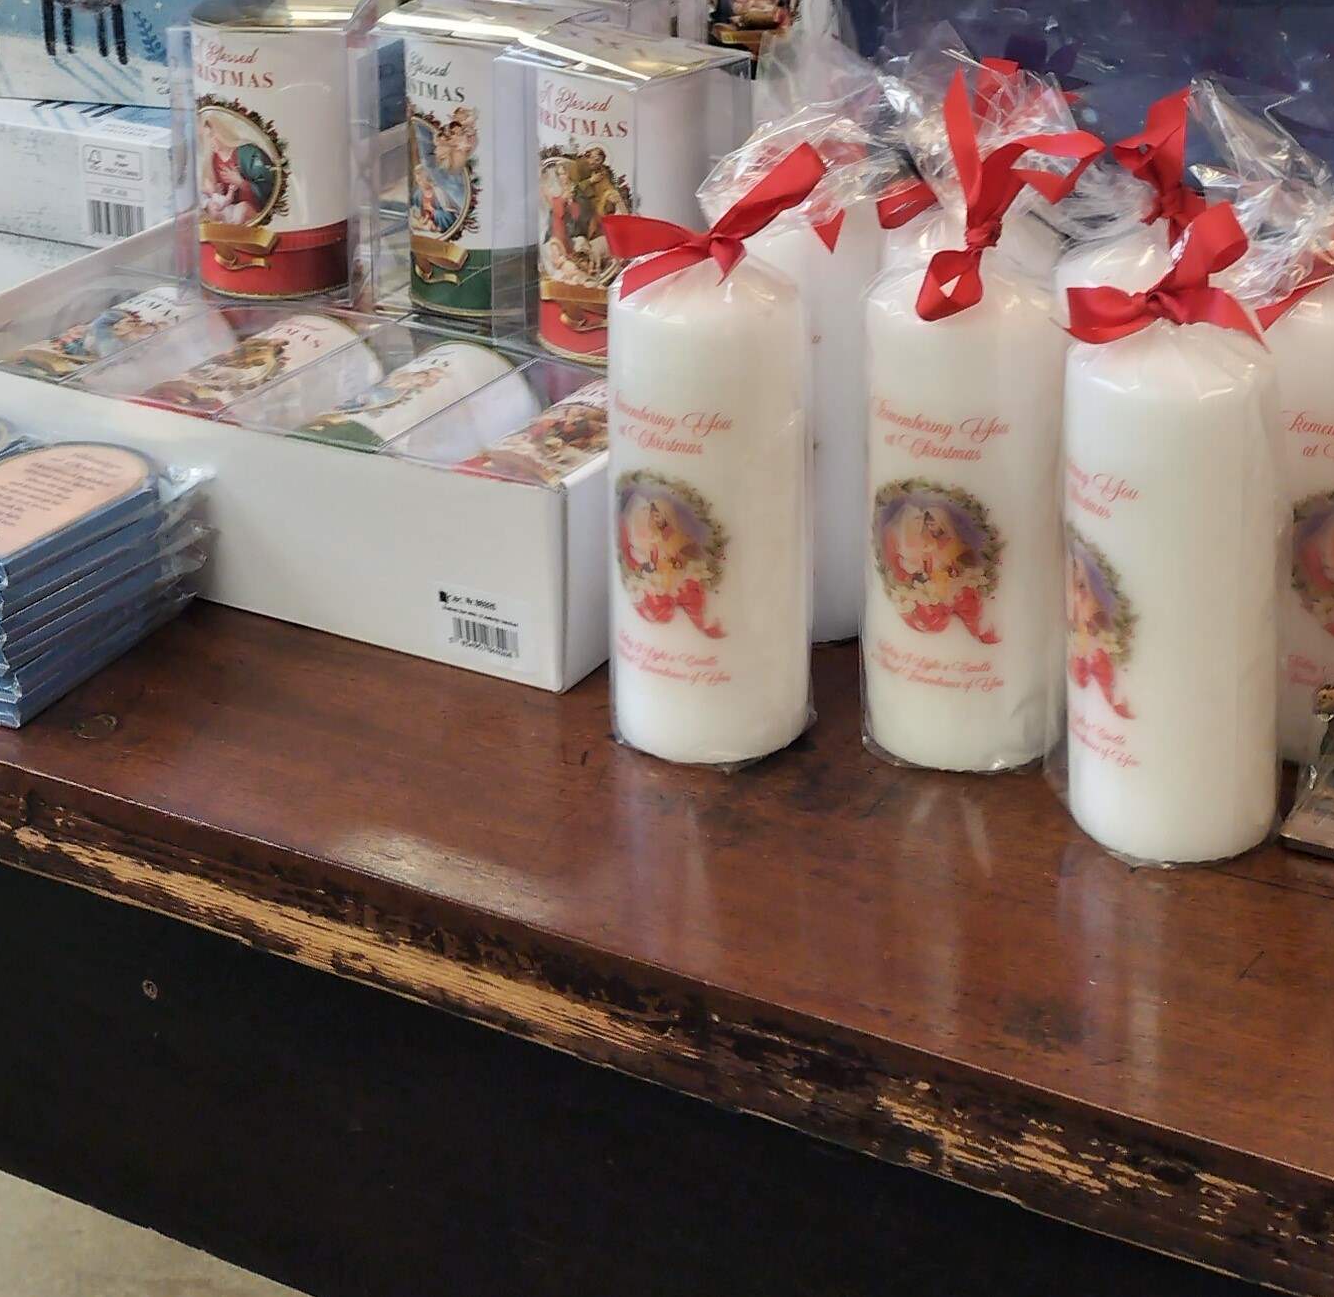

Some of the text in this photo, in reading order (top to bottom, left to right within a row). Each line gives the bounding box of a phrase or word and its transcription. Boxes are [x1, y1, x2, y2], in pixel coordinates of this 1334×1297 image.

[196, 64, 274, 89] RISTMAS
[555, 87, 614, 113] Blessed
[682, 411, 734, 439] You
[960, 416, 1010, 444] You
[629, 424, 703, 455] Christmas
[898, 434, 982, 461] Christmas
[1303, 445, 1318, 457] at
[1093, 473, 1139, 502] You
